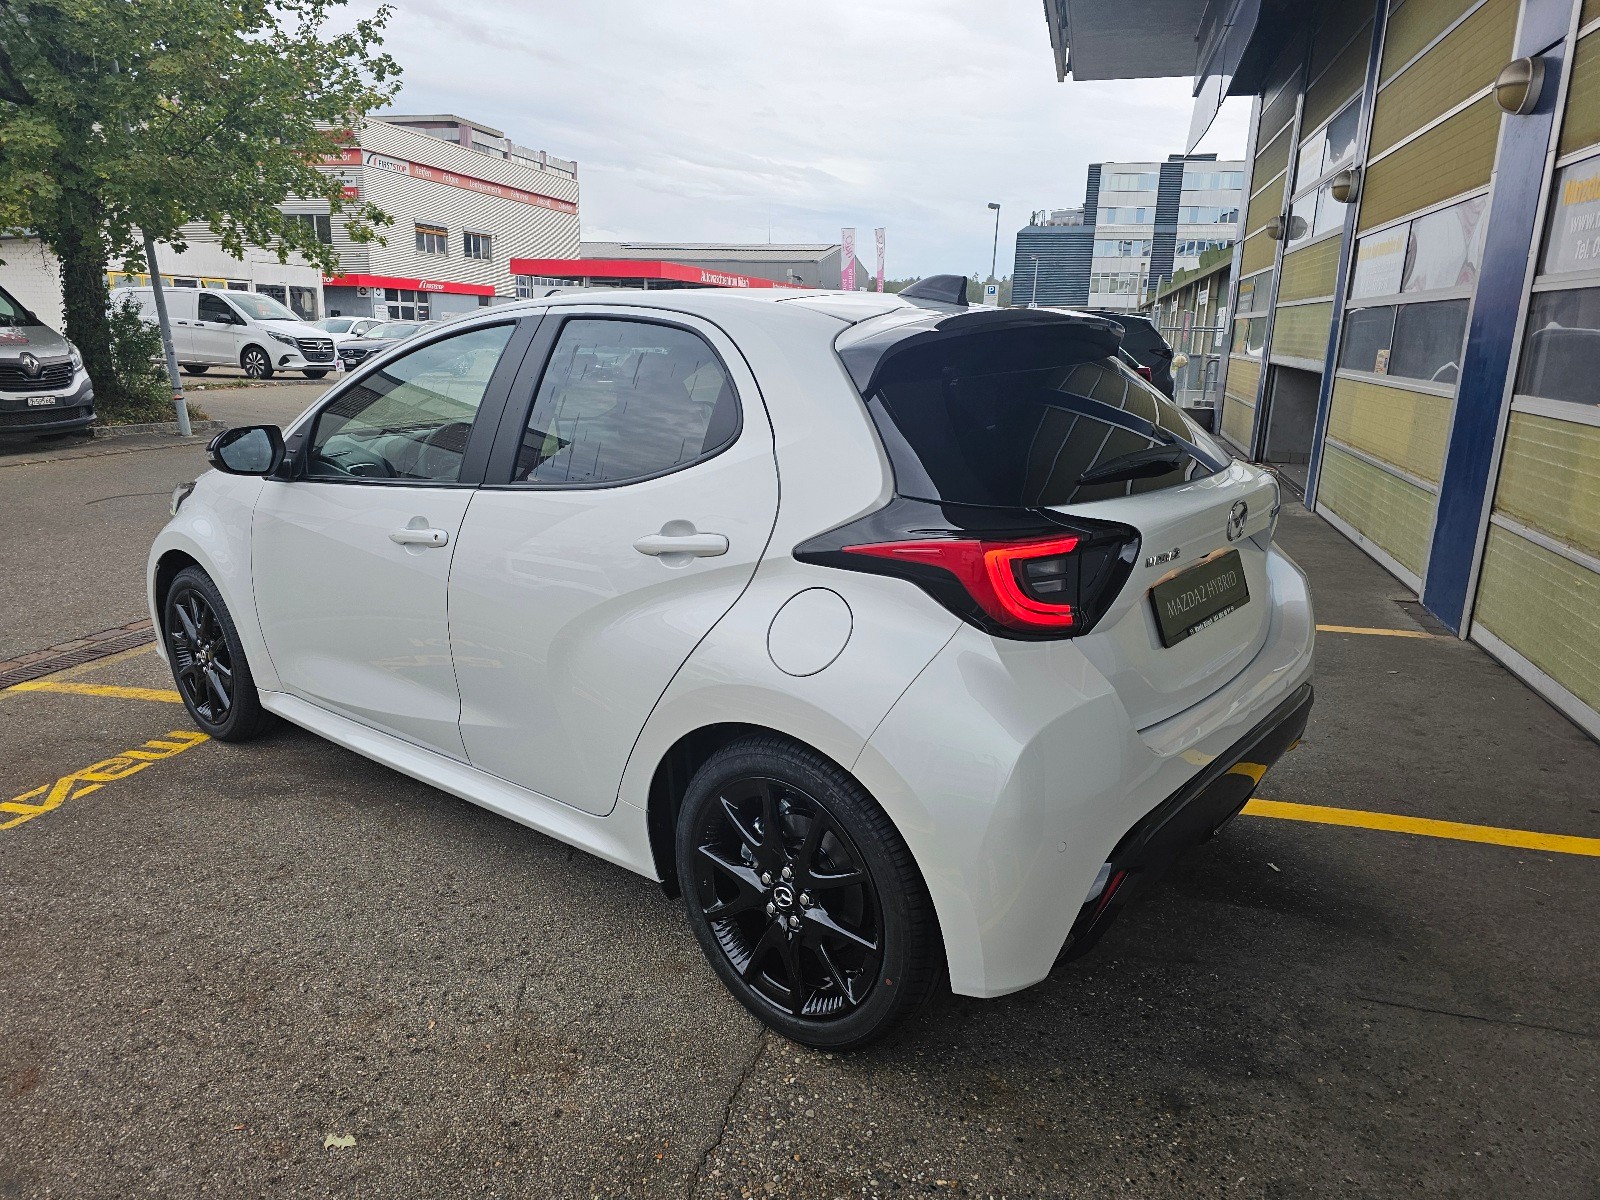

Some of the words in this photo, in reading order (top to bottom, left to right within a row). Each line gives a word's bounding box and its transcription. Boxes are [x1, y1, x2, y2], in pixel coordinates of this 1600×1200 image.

[414, 165, 432, 178] Reifen
[1575, 238, 1589, 260] Tel.
[1166, 585, 1207, 618] MAZDA2
[1206, 570, 1237, 597] HYBRID
